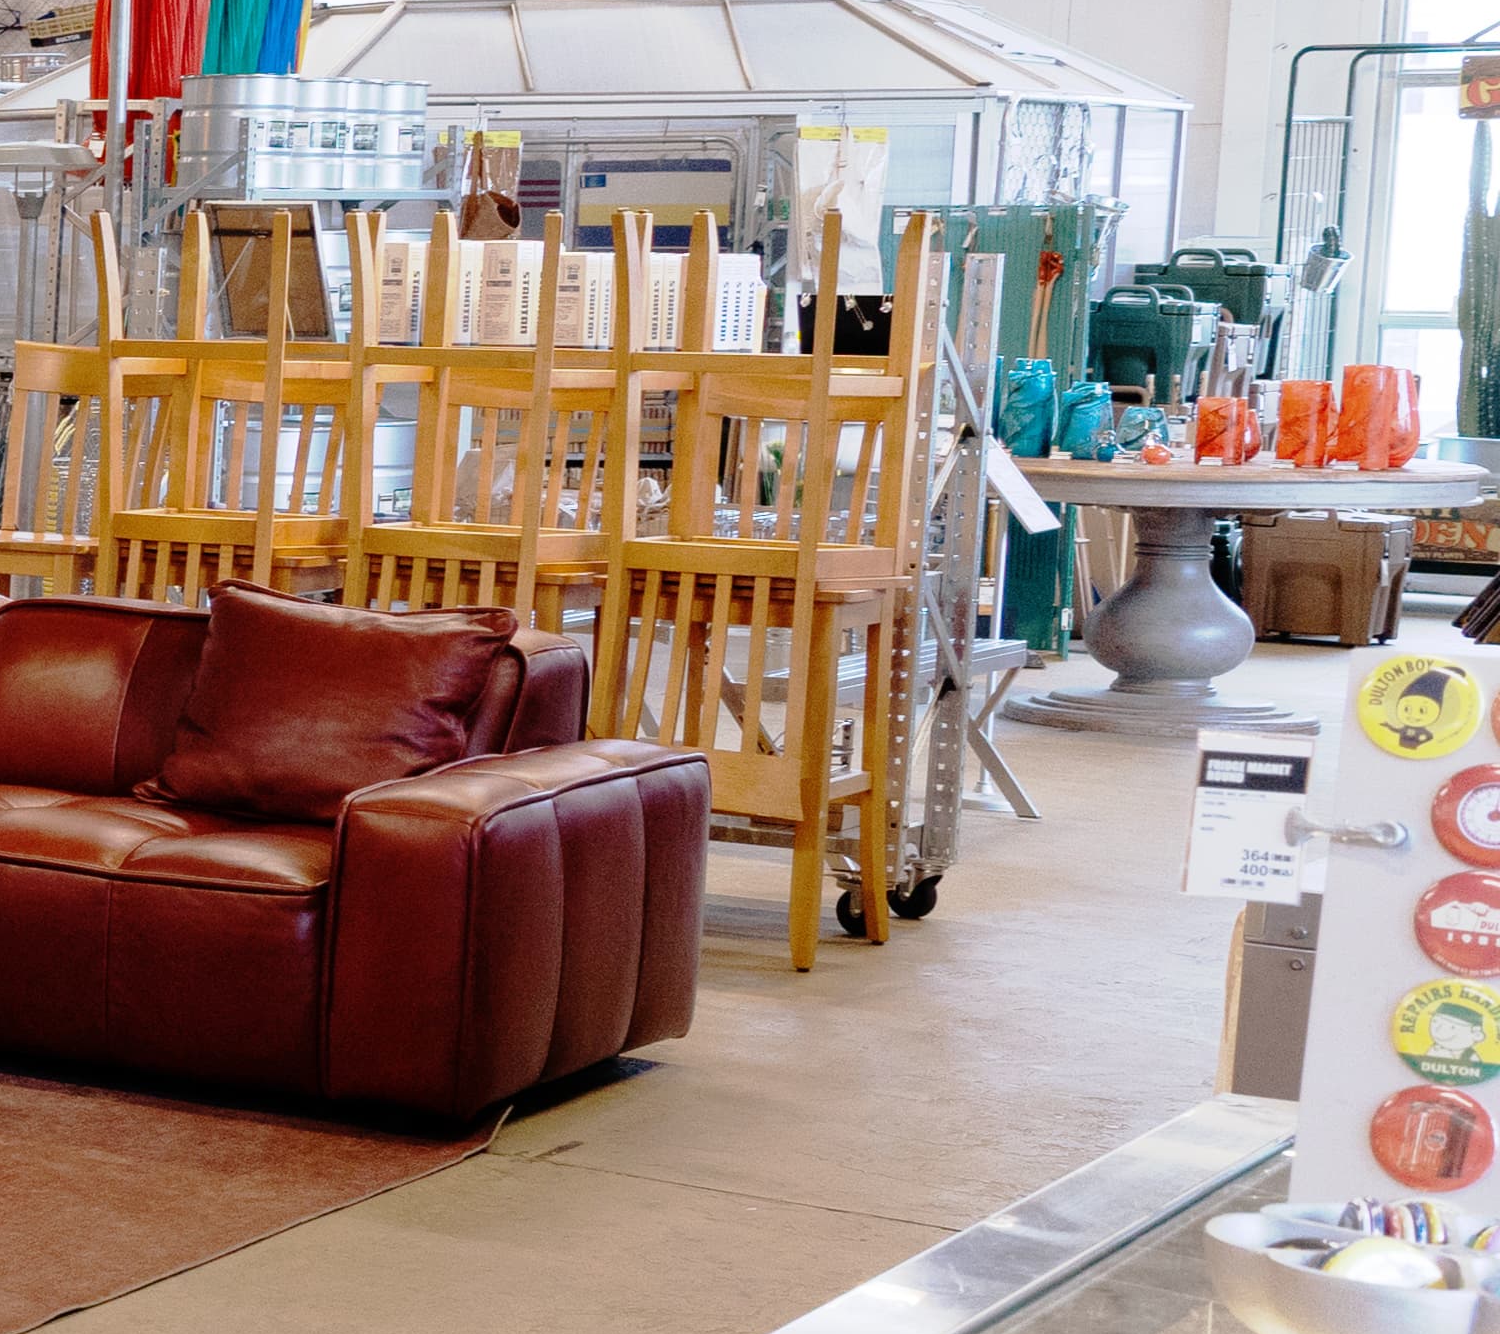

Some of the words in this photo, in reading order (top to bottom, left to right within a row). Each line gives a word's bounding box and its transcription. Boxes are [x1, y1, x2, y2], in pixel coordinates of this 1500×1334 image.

[1368, 664, 1405, 706] DULTON
[1405, 659, 1434, 673] BOY
[1242, 849, 1270, 861] 364
[1240, 864, 1268, 875] 400
[1400, 985, 1453, 1033] REPAIRS
[1421, 1061, 1480, 1078] DULTON
